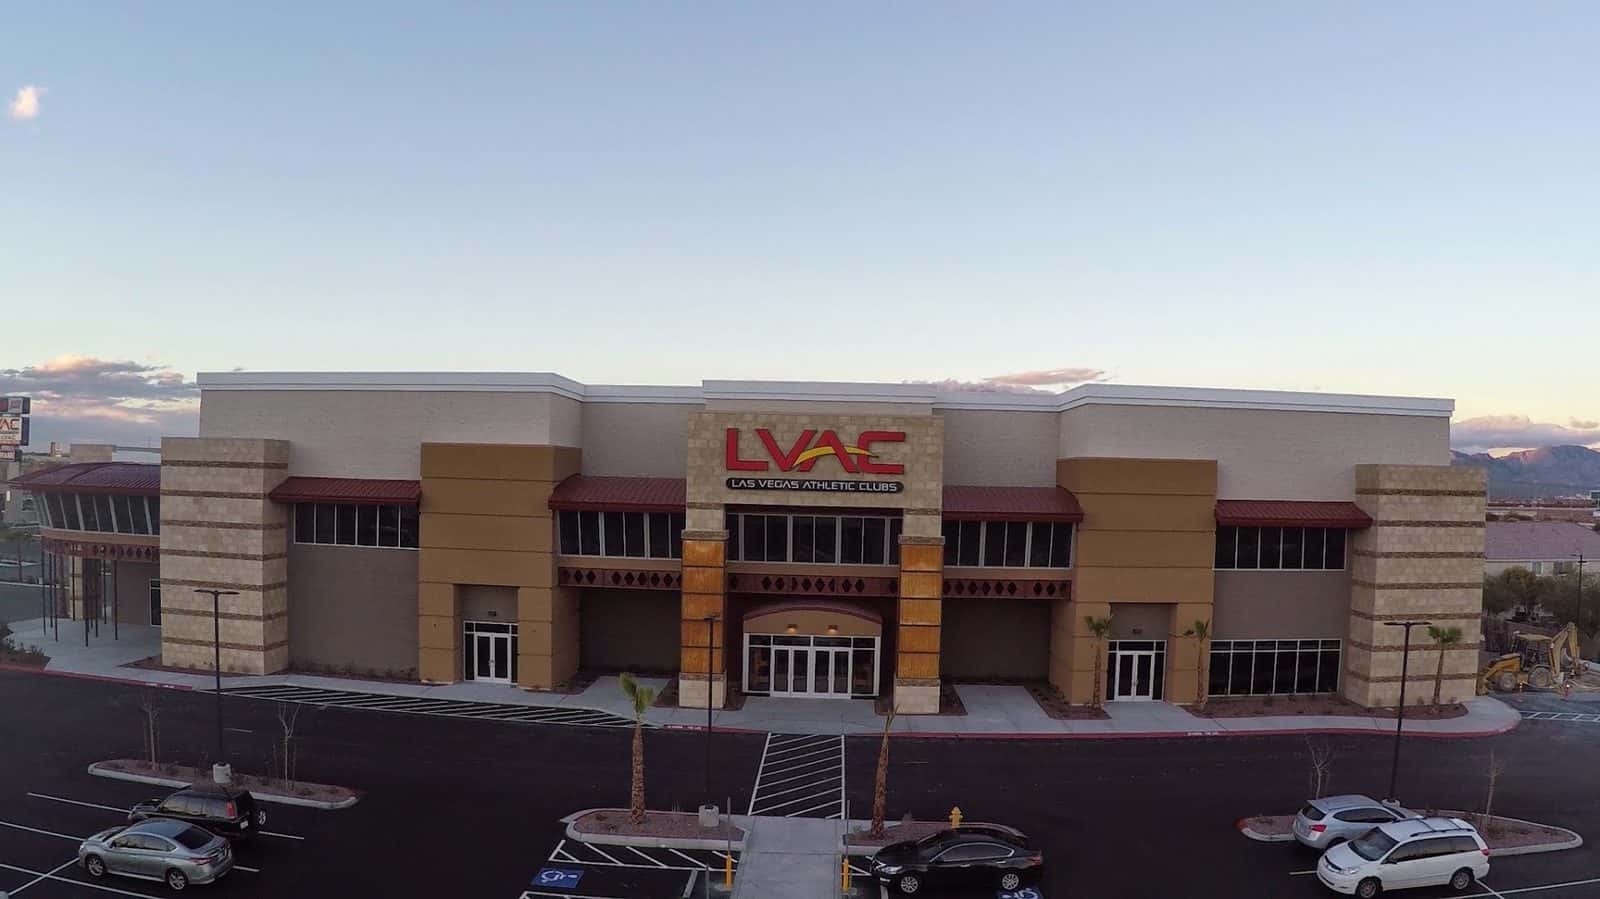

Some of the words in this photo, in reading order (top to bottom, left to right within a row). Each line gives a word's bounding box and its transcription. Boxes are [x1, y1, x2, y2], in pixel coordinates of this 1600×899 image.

[726, 428, 906, 474] LVAC
[731, 479, 756, 488] LAS
[758, 479, 799, 489] VEGAS
[802, 480, 856, 491] ATHLETIC
[859, 482, 897, 492] CLUBS
